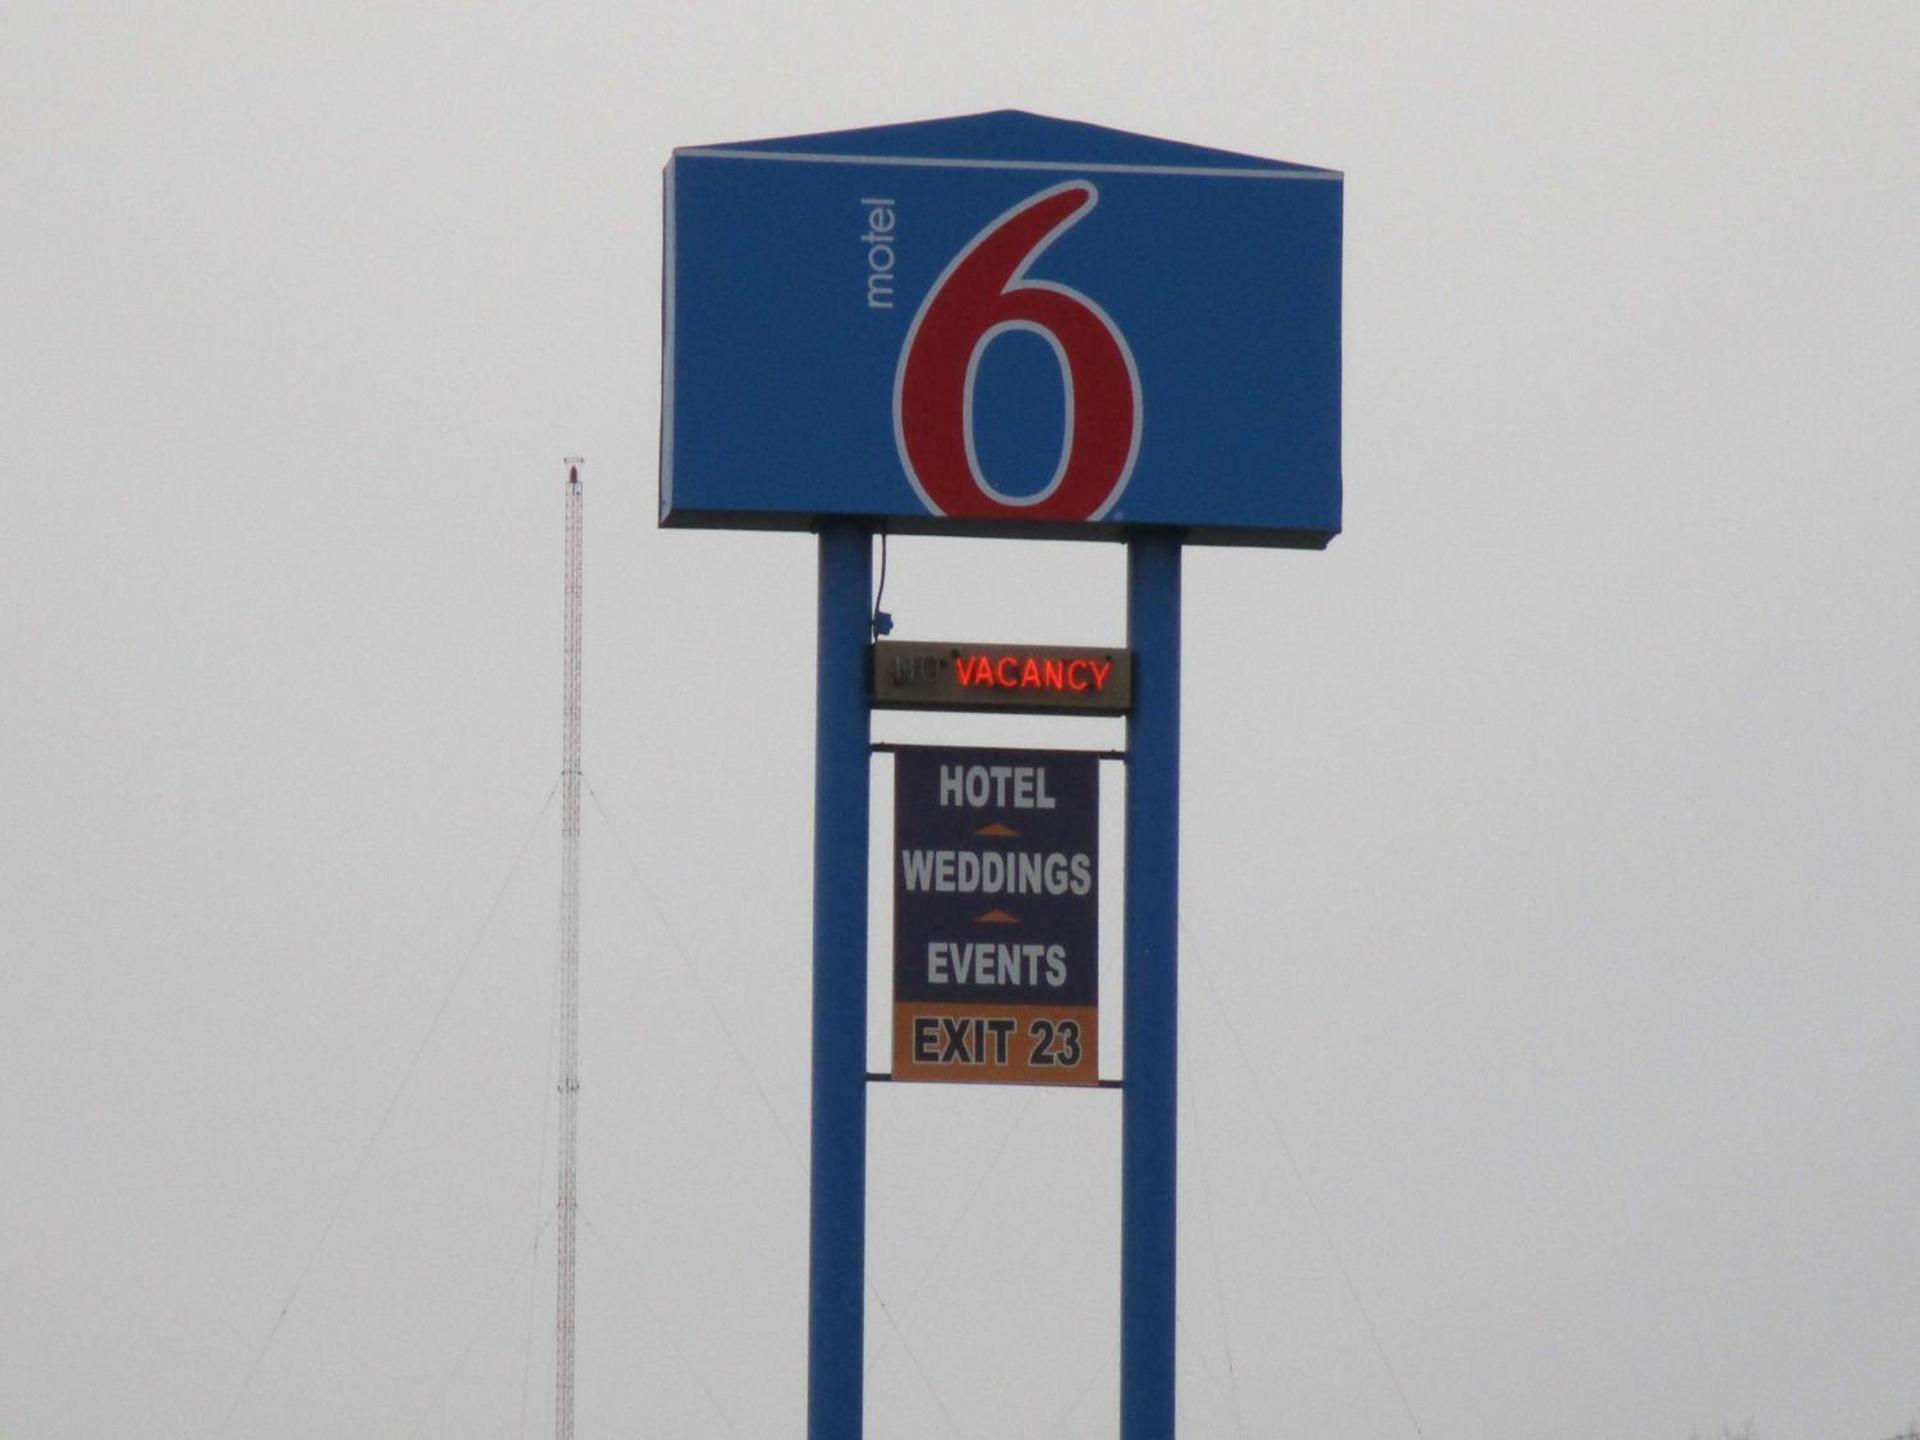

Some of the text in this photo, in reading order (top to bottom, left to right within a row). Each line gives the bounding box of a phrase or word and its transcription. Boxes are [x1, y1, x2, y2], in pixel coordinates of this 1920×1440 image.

[860, 179, 1143, 523] motel 6
[954, 655, 1112, 690] VACANCY
[939, 765, 1056, 809] HOTEL
[902, 850, 1092, 896] WEDDINGS
[927, 941, 1068, 987] EVENTS
[912, 1015, 1082, 1067] EXIT 23
